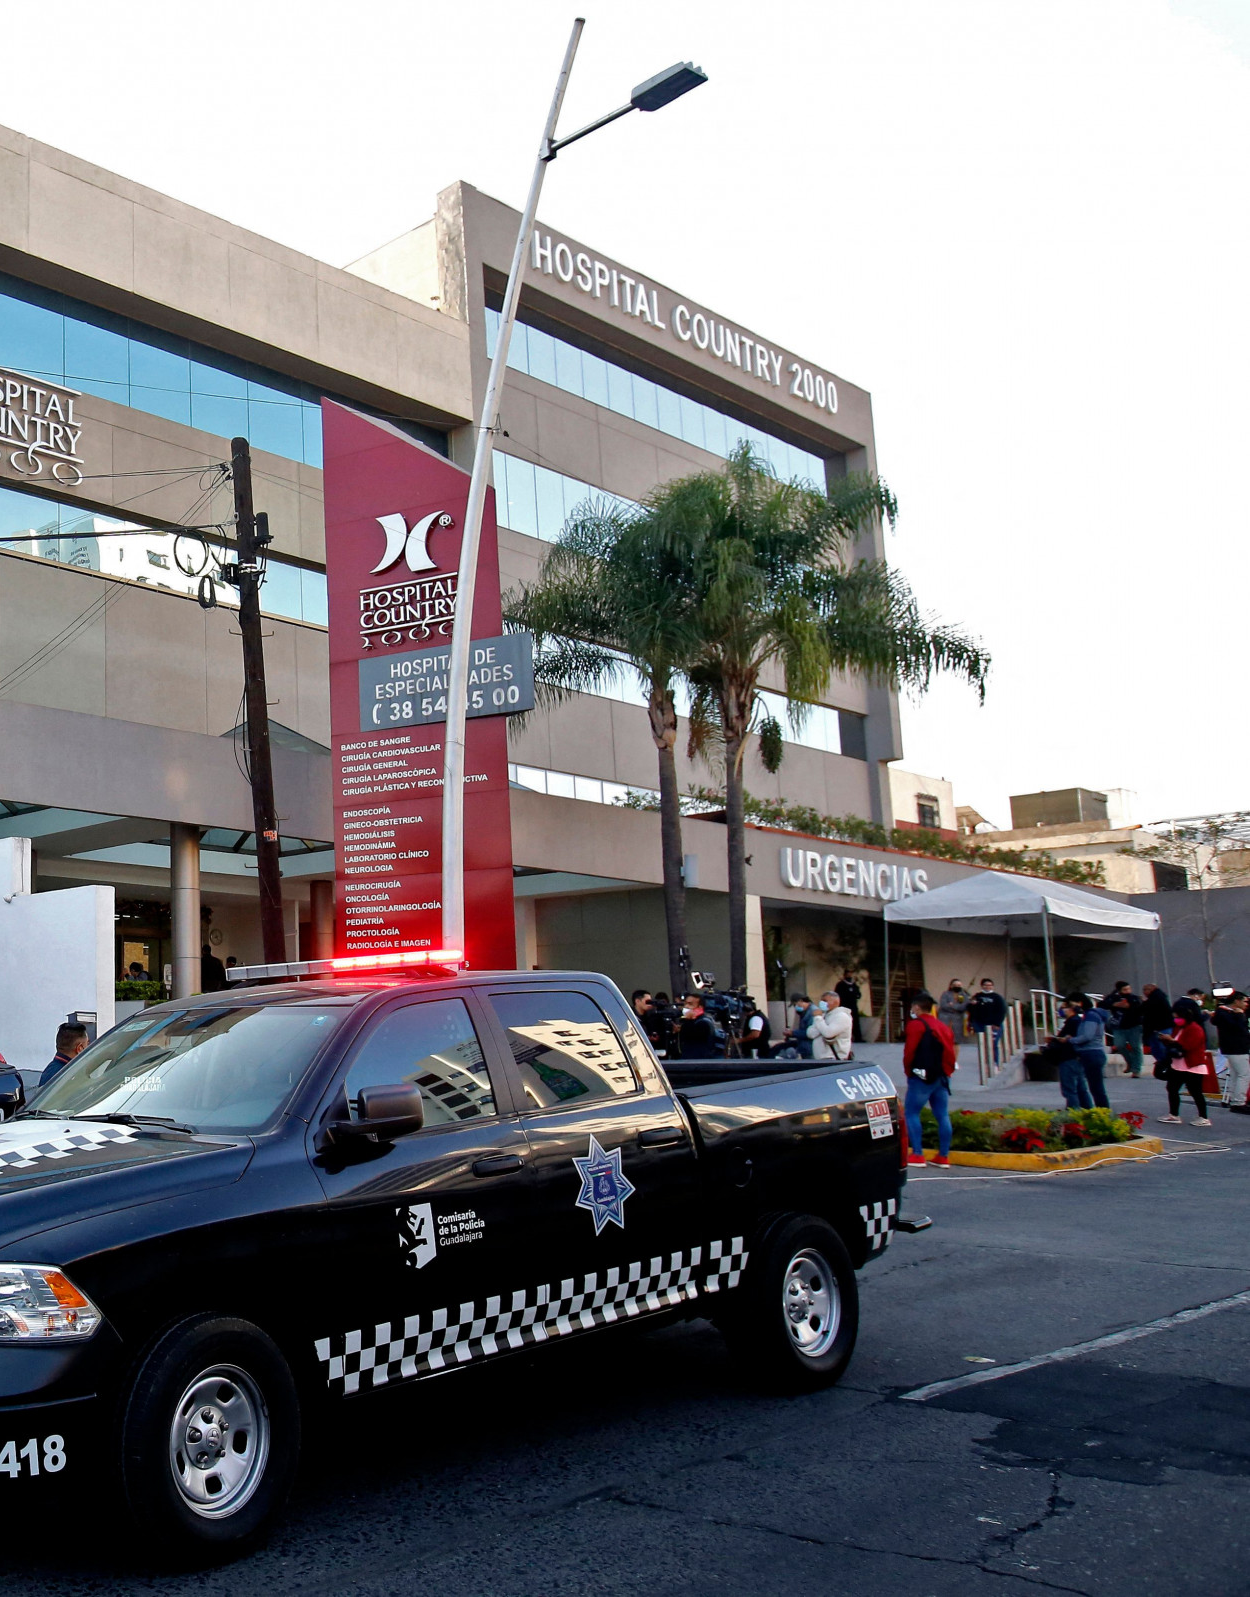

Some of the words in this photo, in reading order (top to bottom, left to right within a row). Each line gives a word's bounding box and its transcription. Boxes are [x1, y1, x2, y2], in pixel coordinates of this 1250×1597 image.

[531, 230, 666, 330] HOSPITAL
[671, 304, 783, 386] COUNTRY
[788, 363, 838, 414] 2000
[360, 579, 458, 611] HOSPITAL
[360, 597, 457, 628] COUNTRY
[391, 654, 452, 679] HOSPIT
[475, 647, 496, 665] DE
[375, 664, 514, 700] ESPECIALADES
[389, 700, 413, 721] 38
[421, 696, 447, 717] 54
[466, 690, 484, 710] 5
[493, 685, 520, 706] 00
[341, 742, 367, 751] BANCO
[368, 740, 378, 748] DE
[380, 736, 411, 746] SANGRE
[341, 751, 371, 762] CIRUGÍA
[372, 743, 441, 758] CARDIOVASCULAR
[342, 763, 371, 773] CIRUGÍA
[372, 760, 408, 770] GENERAL
[342, 774, 372, 785] CIRUGÍA
[373, 767, 437, 781] LAPAROSCÓPICA
[342, 785, 372, 796] CIRUGÍA
[374, 780, 410, 792] PLÁSTICA
[418, 774, 488, 788] RECONCTIVA
[343, 806, 391, 818] ENDOSCOPÍA
[343, 816, 423, 829] GINECO-OBSTETRICIA
[344, 829, 395, 841] HEMODIÁLISIS
[344, 853, 397, 863] LABORATORIO
[398, 850, 429, 859] CLÍNICO
[344, 864, 393, 874] NEUROLOGIA
[780, 847, 928, 900] URGENCIAS
[345, 880, 401, 891] NEUROCIRUGÍA
[345, 892, 390, 903] ONCOLOGÍA
[346, 900, 441, 914] OTORRINOLARINGOLOGÍA
[346, 916, 384, 926] PEDIATRÍA
[346, 927, 400, 937] PROCTOLOGÍA
[347, 939, 393, 949] RADIOLOGÍA
[401, 939, 431, 947] IMAGEN
[836, 1072, 887, 1100] G-1418
[868, 1103, 887, 1116] 911
[439, 1226, 449, 1235] de
[450, 1224, 458, 1233] la
[459, 1218, 485, 1232] Policía
[439, 1231, 483, 1246] Guadalajara
